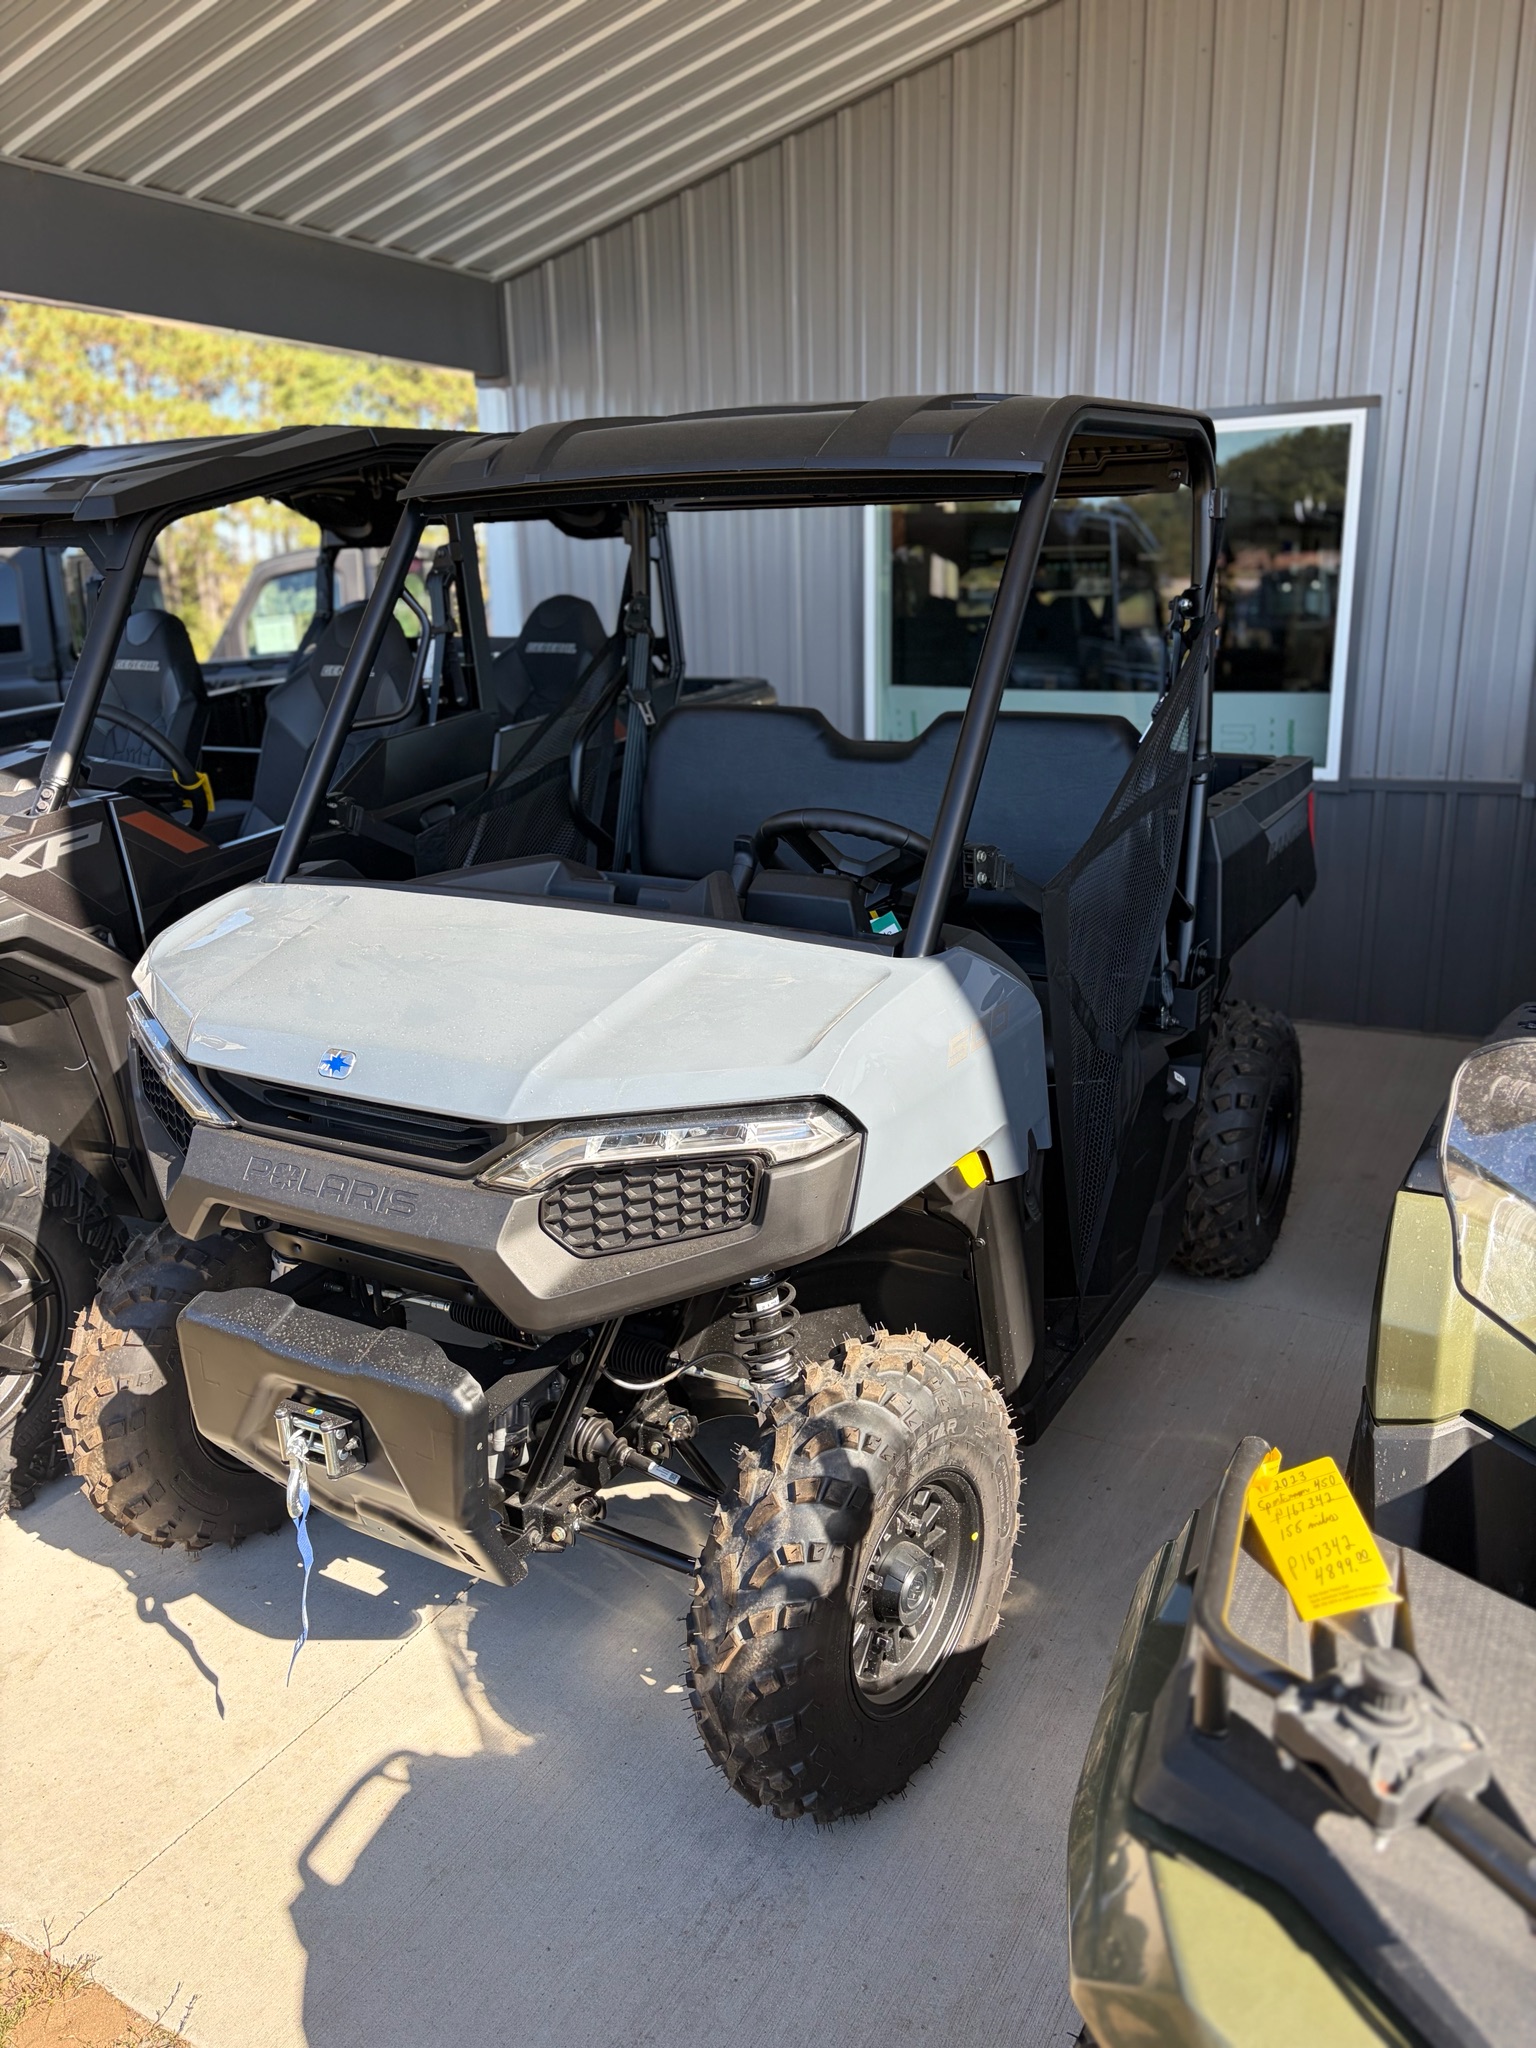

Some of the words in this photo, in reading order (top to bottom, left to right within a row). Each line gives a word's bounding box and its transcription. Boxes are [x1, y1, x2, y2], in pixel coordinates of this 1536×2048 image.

[243, 1156, 419, 1218] POLARIS
[1274, 1470, 1307, 1491] 2023
[1314, 1475, 1336, 1491] 450
[1275, 1492, 1334, 1524] P167342
[1307, 1512, 1339, 1529] miles
[1287, 1534, 1356, 1581] P167342
